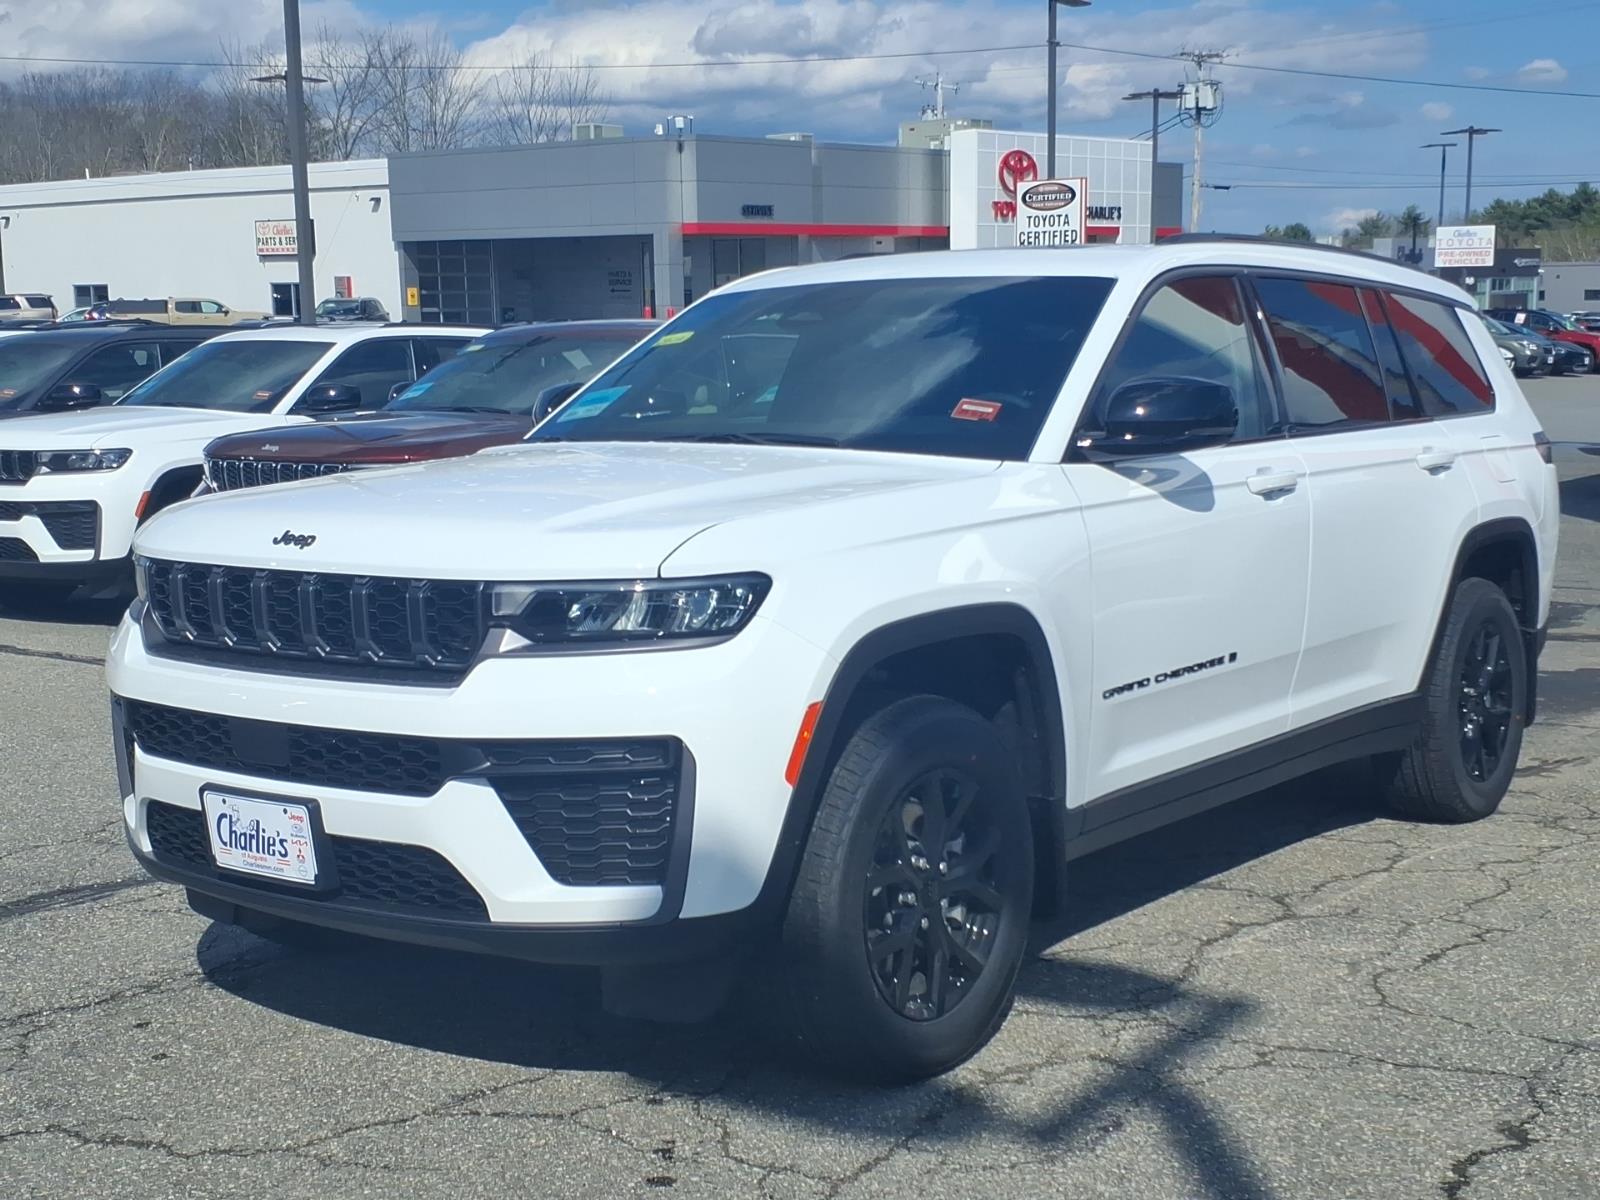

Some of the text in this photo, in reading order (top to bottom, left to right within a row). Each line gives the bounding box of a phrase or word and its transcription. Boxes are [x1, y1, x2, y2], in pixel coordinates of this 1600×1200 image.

[1026, 214, 1070, 228] TOYOTA
[257, 236, 277, 247] PARTS
[278, 236, 283, 246] &
[1018, 229, 1078, 246] CERTIFIED
[1438, 238, 1493, 248] TOYOTA
[1438, 250, 1491, 258] PRE-OWNED
[272, 530, 317, 550] Jeep
[1102, 678, 1151, 699] GRAND
[1154, 655, 1226, 684] CHEROKEE
[287, 811, 305, 823] Jeep
[216, 812, 289, 858] Charlie's
